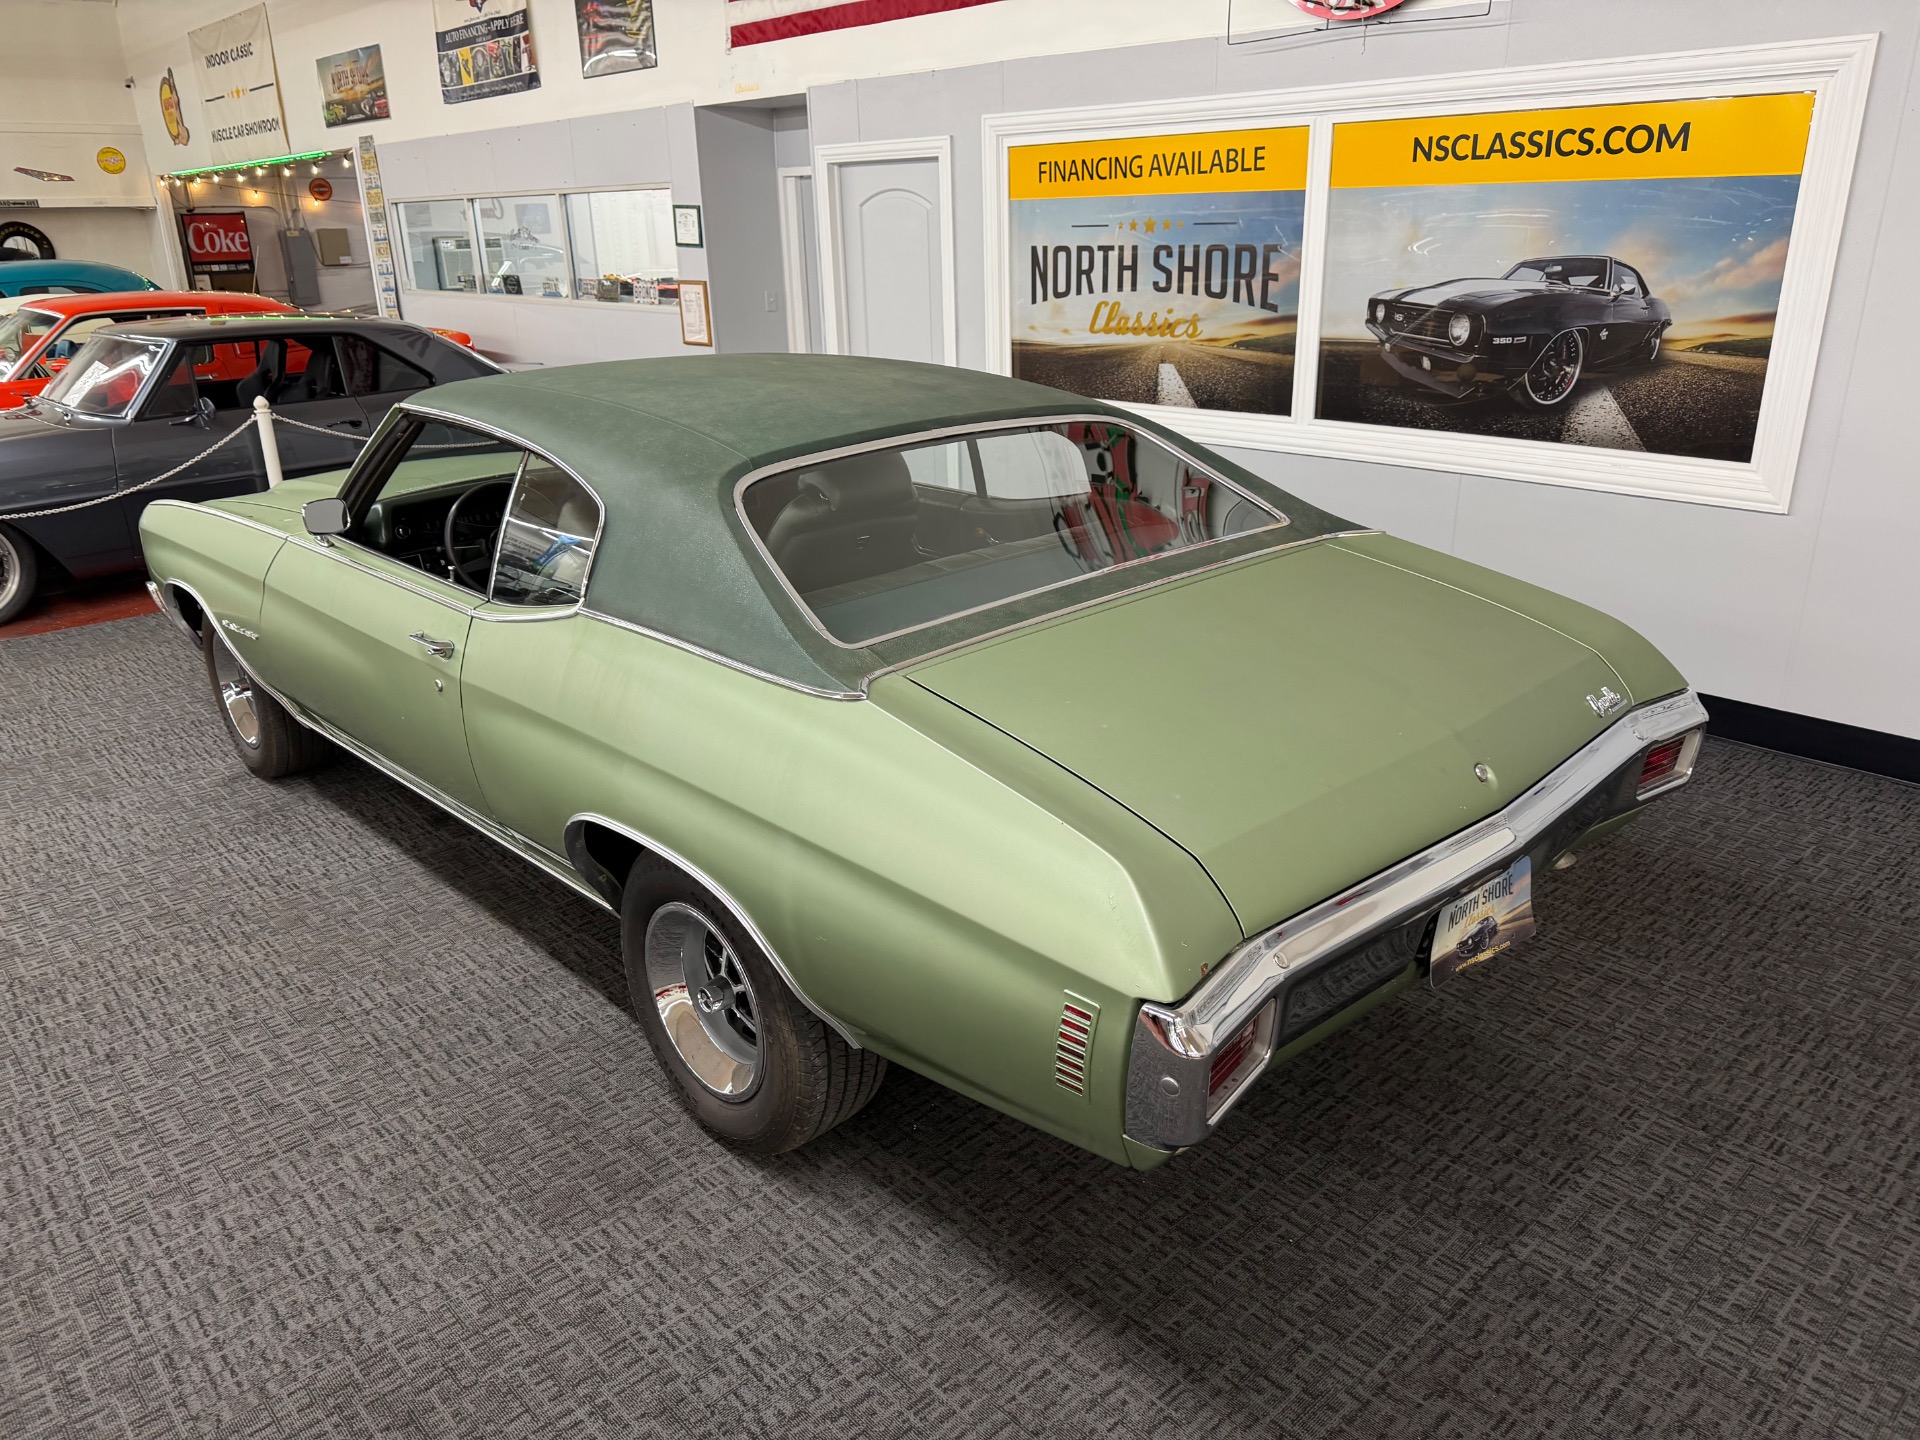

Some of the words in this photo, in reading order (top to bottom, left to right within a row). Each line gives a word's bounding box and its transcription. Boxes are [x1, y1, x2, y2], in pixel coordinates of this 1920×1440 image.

[445, 31, 460, 44] AUTO
[509, 13, 525, 28] HERE
[204, 50, 231, 69] INDOOR
[230, 41, 254, 62] CLASSIC
[211, 126, 235, 143] MUSCLE
[233, 123, 246, 139] CAR
[244, 116, 281, 137] SHOWROOM
[1411, 121, 1692, 163] NSCLASSICS.COM
[1038, 155, 1143, 183] FINANCING
[1148, 146, 1266, 178] AVAILABLE
[188, 222, 250, 254] Coke
[1030, 244, 1138, 305] NORTH
[1152, 243, 1283, 314] SHORE
[1088, 300, 1204, 339] Classics
[1492, 336, 1513, 345] 350
[1447, 894, 1480, 932] NORTH
[1482, 874, 1514, 905] SHORE
[1455, 940, 1511, 972] www.nsclassics.com
